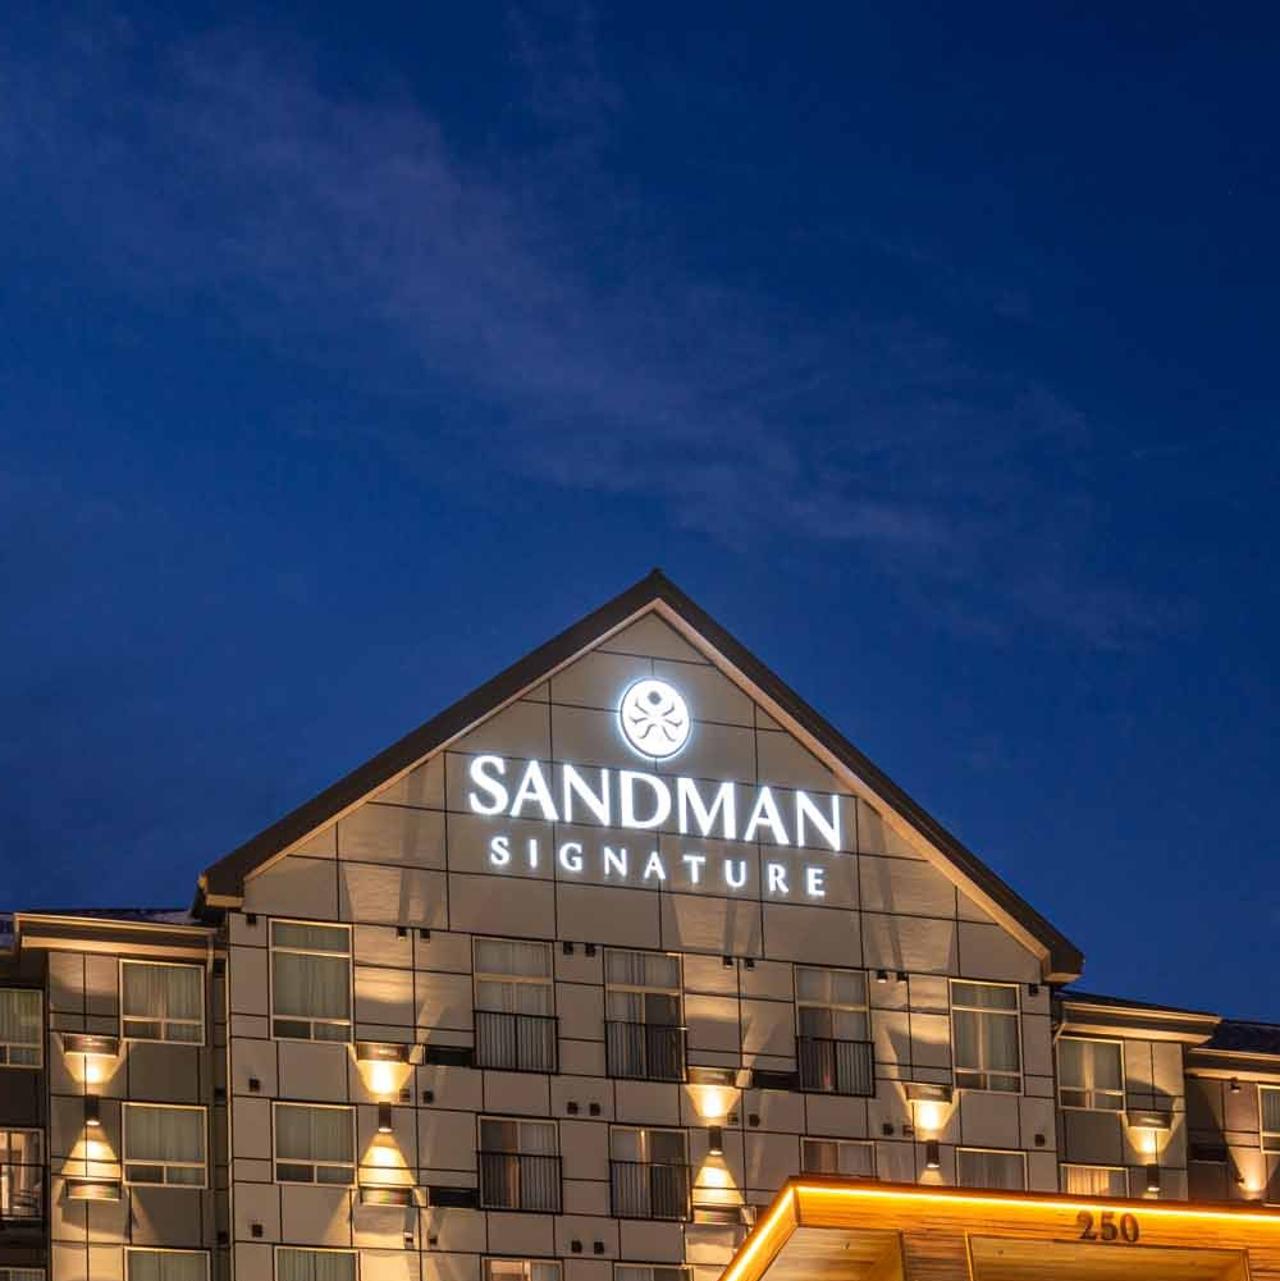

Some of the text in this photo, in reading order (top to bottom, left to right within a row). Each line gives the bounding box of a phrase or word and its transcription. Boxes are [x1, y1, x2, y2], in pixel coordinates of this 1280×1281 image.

[468, 754, 843, 852] SANDMAN
[490, 835, 826, 897] SIGNATURE
[1076, 1209, 1141, 1244] 250
